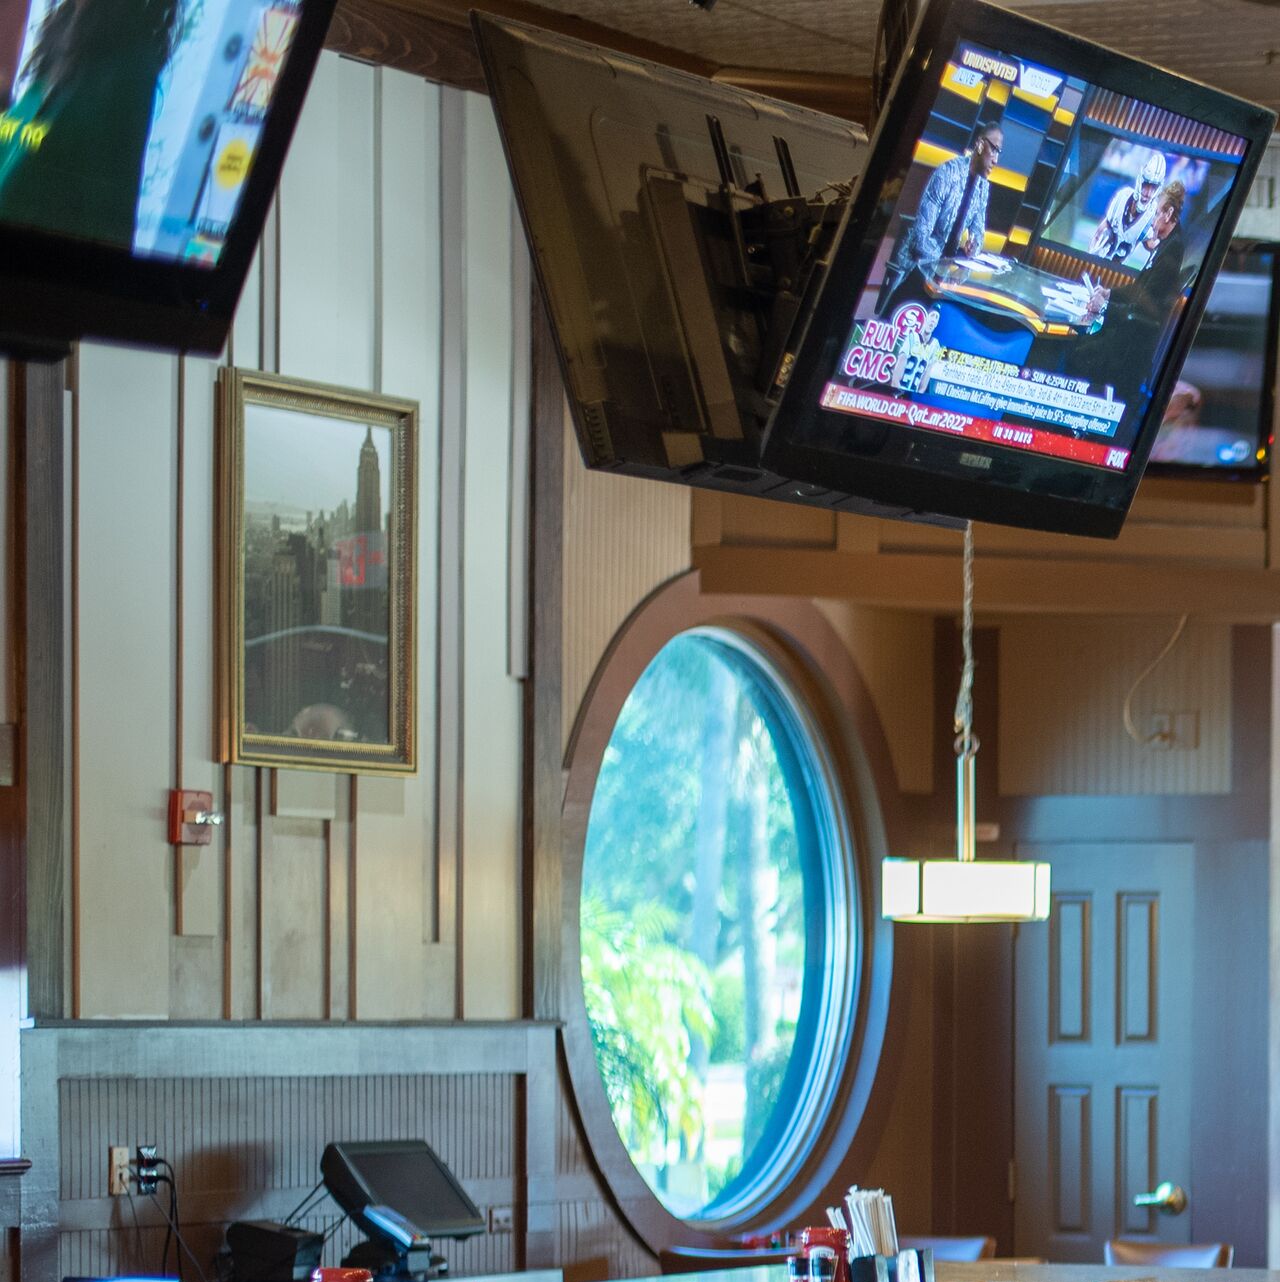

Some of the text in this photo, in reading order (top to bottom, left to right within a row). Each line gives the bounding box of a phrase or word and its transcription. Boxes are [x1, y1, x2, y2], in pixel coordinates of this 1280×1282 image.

[956, 71, 977, 86] LIVE
[962, 49, 1018, 82] UNDISPUTED
[861, 320, 899, 352] RUN
[845, 345, 896, 382] CMC
[942, 364, 966, 379] Panthers
[981, 373, 993, 386] CMC
[1001, 378, 1016, 391] 49ers
[1068, 395, 1082, 408] 2023
[1031, 371, 1046, 384] SUN
[1045, 375, 1068, 390] 4:25PM
[1075, 381, 1090, 395] FOX
[837, 391, 857, 407] FIFA
[856, 395, 888, 415] WORLD
[887, 401, 906, 419] CUP
[935, 381, 946, 393] Will
[946, 384, 971, 399] Christian
[969, 390, 997, 408] McCaffrey
[1007, 399, 1035, 415] immediate
[1063, 413, 1088, 430] struggling
[1087, 419, 1109, 434] offense?
[1013, 430, 1033, 445] DAYS
[1106, 449, 1128, 469] FOX
